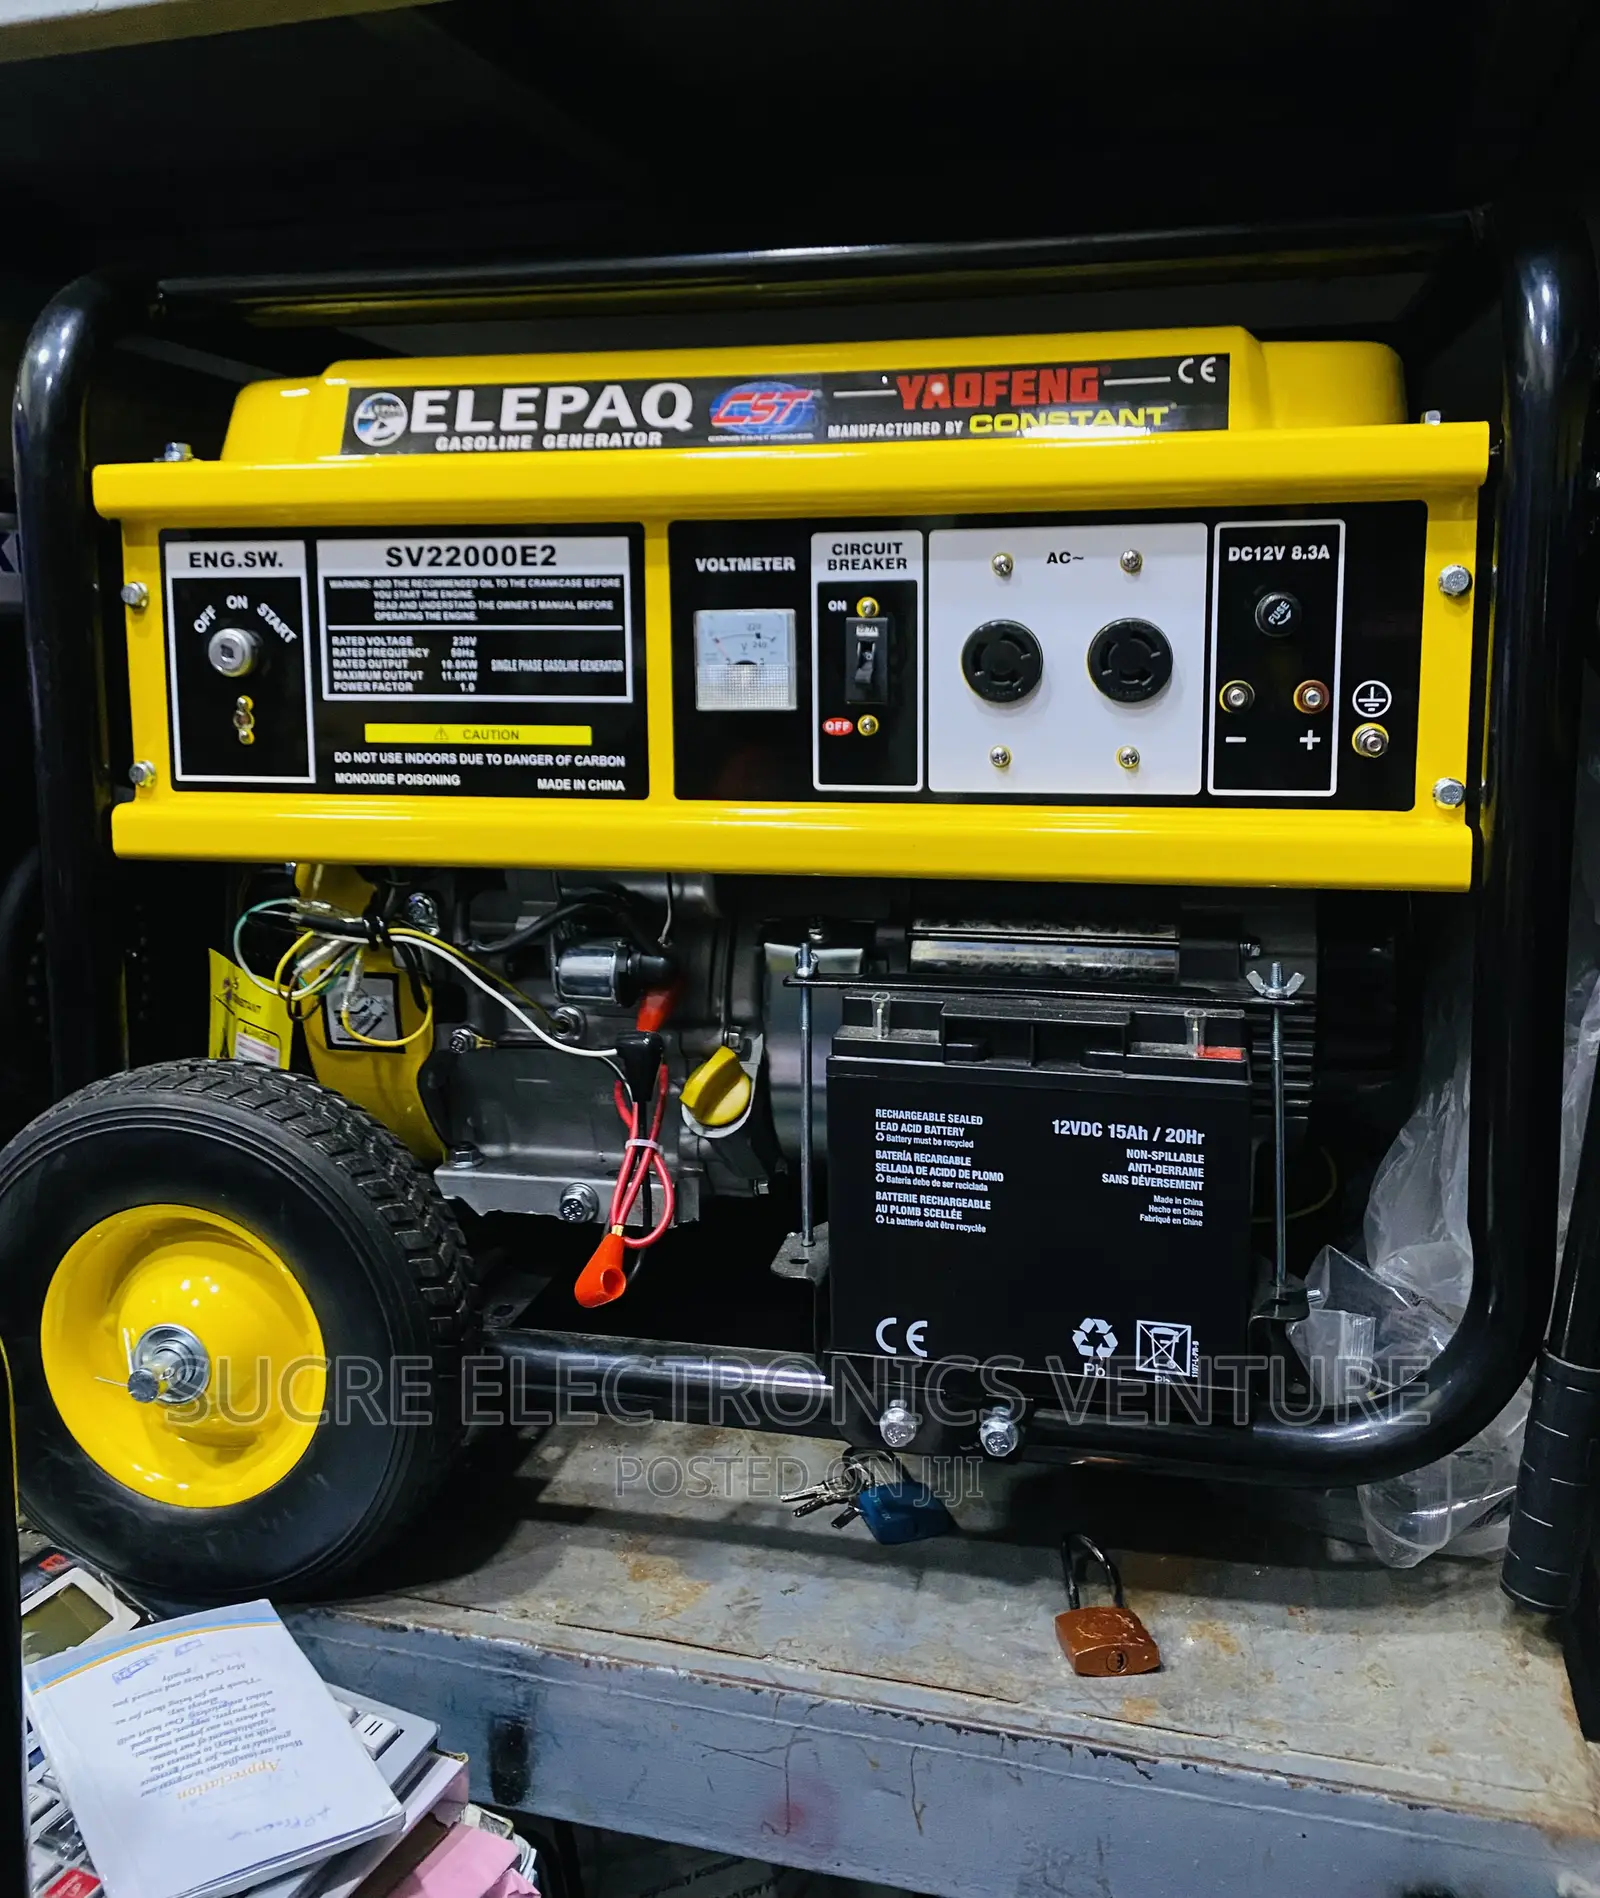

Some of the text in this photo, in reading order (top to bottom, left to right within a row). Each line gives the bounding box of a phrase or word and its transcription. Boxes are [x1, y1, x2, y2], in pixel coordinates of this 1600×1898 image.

[897, 367, 1100, 411] YAOFENG
[409, 382, 694, 433] ELEPAQ
[711, 389, 814, 427] CST
[827, 421, 942, 439] MANUFACTURED
[945, 419, 963, 435] BY
[968, 405, 1169, 435] CONSTANT
[435, 431, 663, 452] GASOLINE GENERATOR
[386, 545, 557, 568] SV22000E2
[832, 542, 903, 556] CIRCUIT
[1228, 545, 1330, 562] DC12V 8.3A
[189, 551, 283, 568] ENG.SW.
[695, 557, 796, 572] VOLTMETER
[827, 557, 908, 571] BREAKER
[393, 579, 410, 589] THE
[495, 578, 509, 588] TO
[509, 578, 527, 588] THE
[583, 578, 621, 588] BEFORE
[373, 589, 393, 600] YOU
[393, 589, 420, 600] START
[421, 589, 440, 600] THE
[226, 595, 249, 610] ON
[373, 600, 399, 610] READ
[399, 600, 418, 610] AND
[418, 600, 477, 610] UNDERSTAND
[478, 600, 496, 610] THE
[576, 600, 614, 610] BEFORE
[828, 600, 847, 612] ON
[193, 605, 217, 634] OFF
[374, 611, 424, 621] OPERATING
[424, 611, 442, 621] THE
[1268, 600, 1290, 625] FUSE
[257, 602, 298, 644] START
[331, 636, 414, 647] RATED VOLTAGE
[332, 647, 430, 659] RATED FREQUENCY
[332, 659, 409, 670] RATED OUTPUT
[491, 659, 624, 673] SINGLE PHASE GASOLINE GENERATOR
[333, 670, 424, 681] MAXIMUM OUTPUT
[333, 681, 414, 693] POWER FACTOR
[460, 682, 476, 693] 1.0
[825, 720, 851, 732] OFF
[463, 728, 520, 740] CAUTION
[334, 751, 626, 768] DO NOT USE INDOORS DUE TO DANGER OF CARBON
[335, 772, 461, 787] MONOXIDE POISONING
[537, 778, 626, 792] MADE IN CHINA
[875, 1108, 983, 1126] RECHARGEABLE SEALED
[875, 1121, 965, 1137] LEAD ACID BATTERY
[1052, 1119, 1205, 1145] 12VDC 15Ah / 20Hr
[886, 1133, 975, 1149] Battery must be recycled
[913, 1152, 972, 1167] RECARGABLE
[1126, 1148, 1205, 1164] NON-SPILLABLE
[875, 1162, 1004, 1183] SELLADA DE ACIDO DE PLOMO
[1127, 1162, 1205, 1178] ANTI-DERRAME
[912, 1177, 931, 1187] debe
[931, 1179, 941, 1188] de
[942, 1181, 954, 1189] ser
[955, 1182, 989, 1192] reciclada
[1102, 1173, 1204, 1191] SANS DÉVERSEMENT
[875, 1191, 992, 1210] BATTERIE RECHARGEABLE
[1153, 1195, 1204, 1207] Made in China
[875, 1203, 963, 1220] AU PLOMB SCELLÉE
[1148, 1204, 1203, 1217] Hecho en China
[886, 1216, 986, 1233] La batterie doit être recyclée
[1139, 1213, 1171, 1225] Fabriqué
[1083, 1362, 1106, 1378] Pb
[276, 1739, 302, 1752] Words
[177, 1759, 282, 1800] Appreciation
